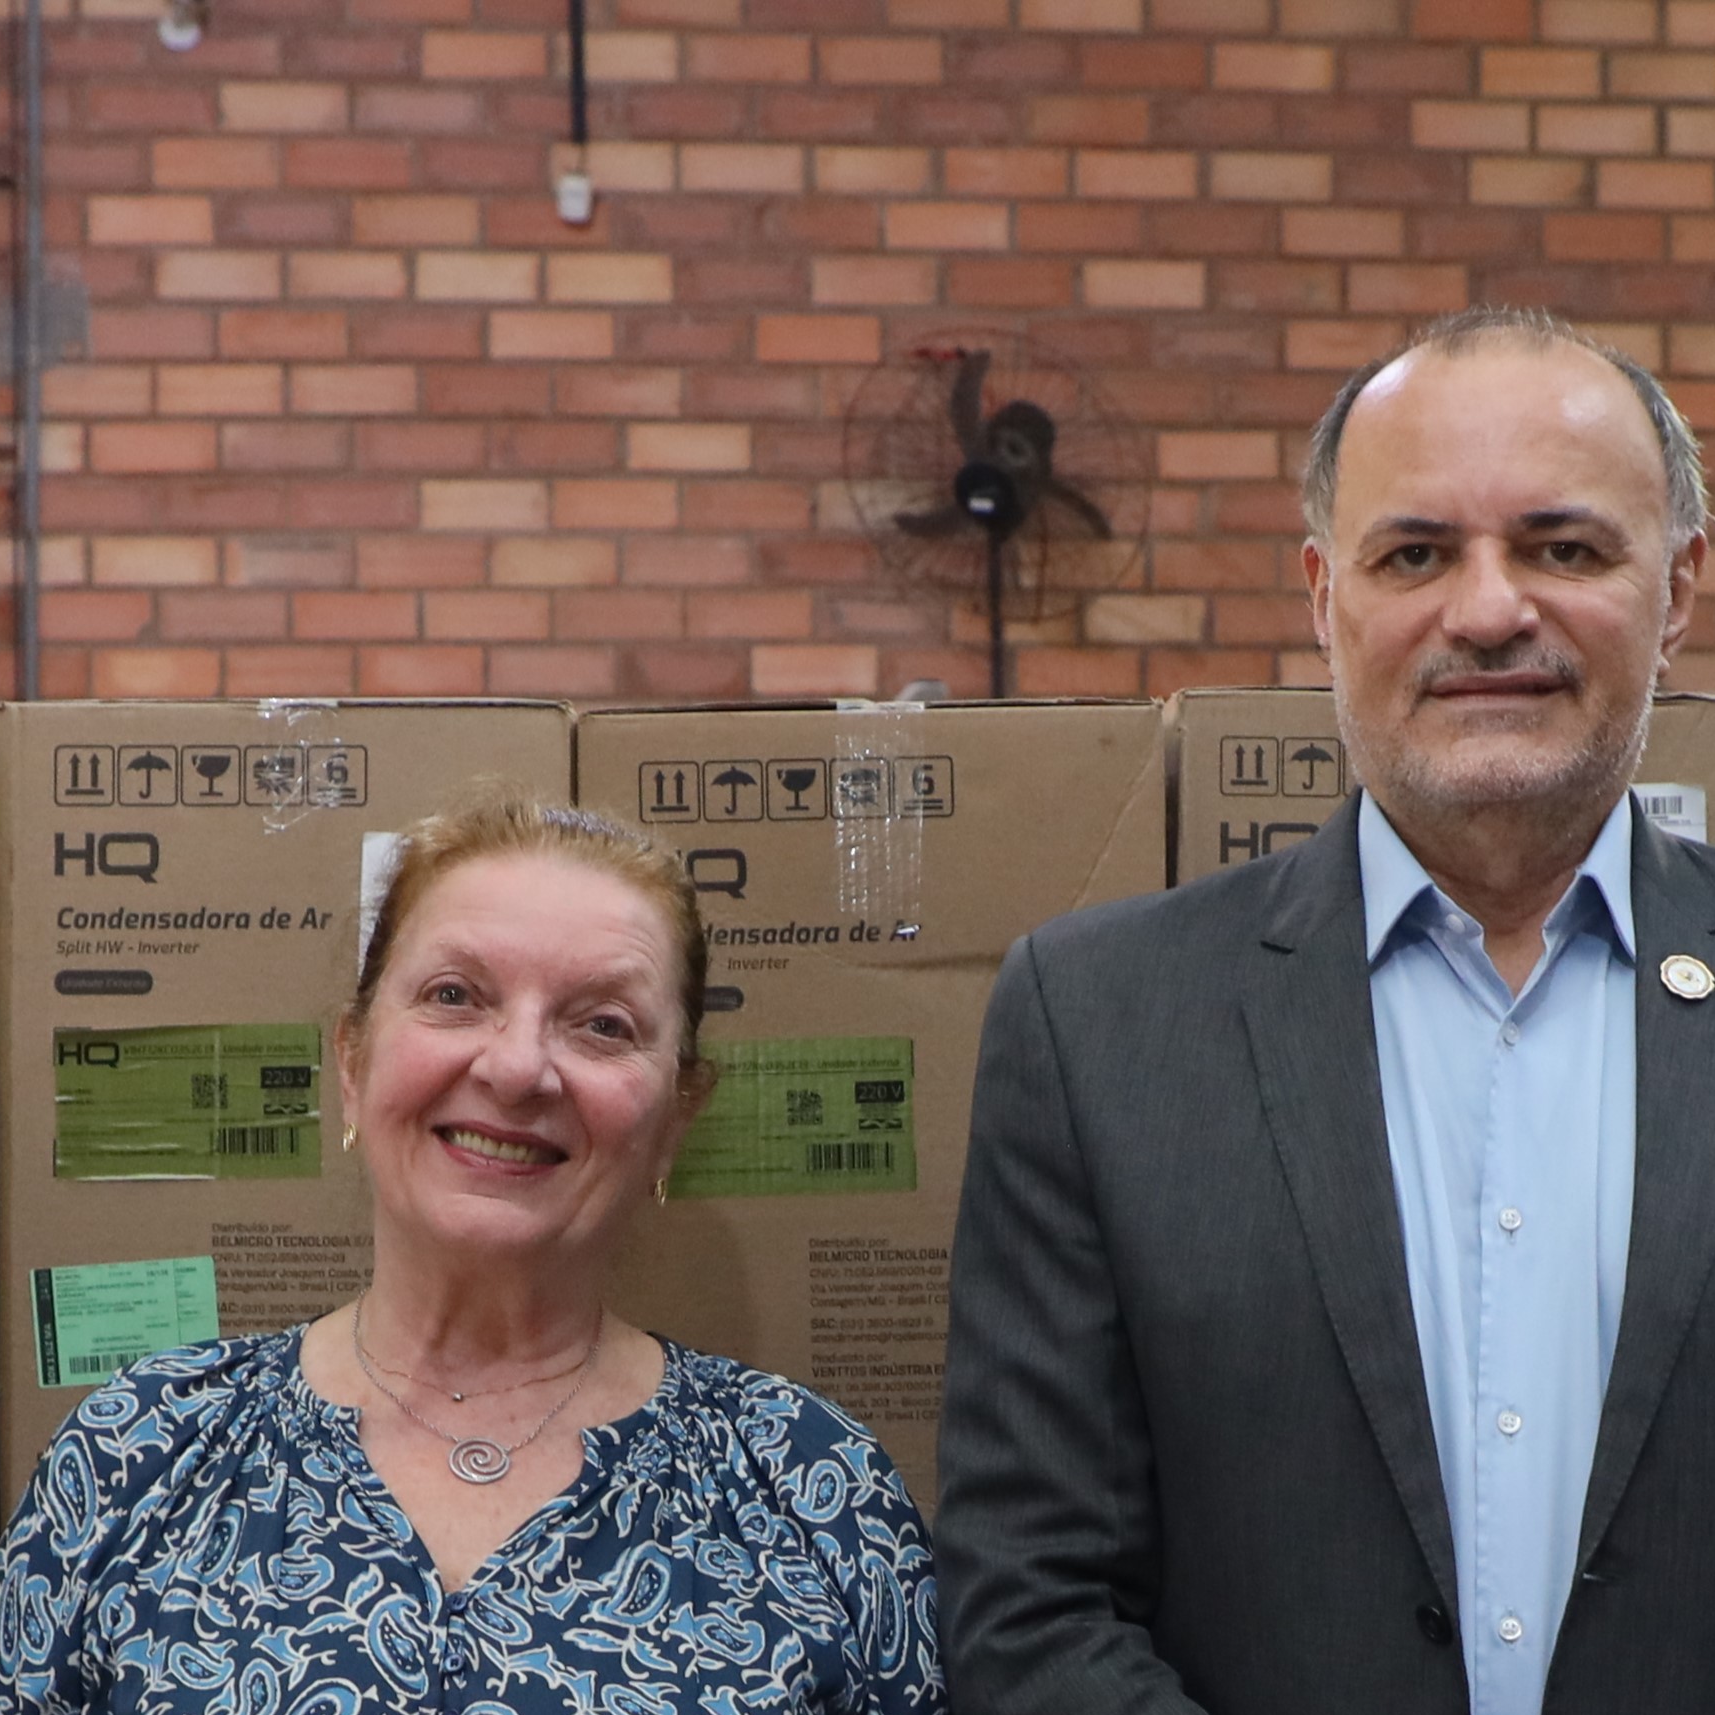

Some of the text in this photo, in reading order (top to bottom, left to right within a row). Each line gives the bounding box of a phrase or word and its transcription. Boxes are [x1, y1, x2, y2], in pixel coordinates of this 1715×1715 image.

[326, 753, 348, 784] 6
[913, 764, 935, 796] 6
[54, 833, 159, 883] HQ
[676, 849, 747, 899] Q
[57, 907, 333, 930] Condensadora de Ar
[703, 922, 839, 945] densadora
[848, 921, 881, 943] de
[56, 941, 91, 957] Split
[95, 941, 123, 955] HW
[138, 941, 202, 955] Inverter
[728, 957, 790, 970] Inverter
[58, 1042, 119, 1068] HQ
[264, 1069, 294, 1085] 220
[858, 1083, 903, 1100] 220 V
[212, 1223, 270, 1235] Distribuído
[212, 1236, 273, 1248] BELMICRO
[276, 1235, 351, 1248] TECNOLOGIA
[809, 1248, 948, 1262] BELMICRO TECNOLOGIA
[280, 1266, 325, 1280] Joaquim
[219, 1282, 287, 1294] ontagem/MG
[219, 1302, 237, 1315] AC:
[812, 1362, 934, 1378] VENTTOS INDÚSTRIA
